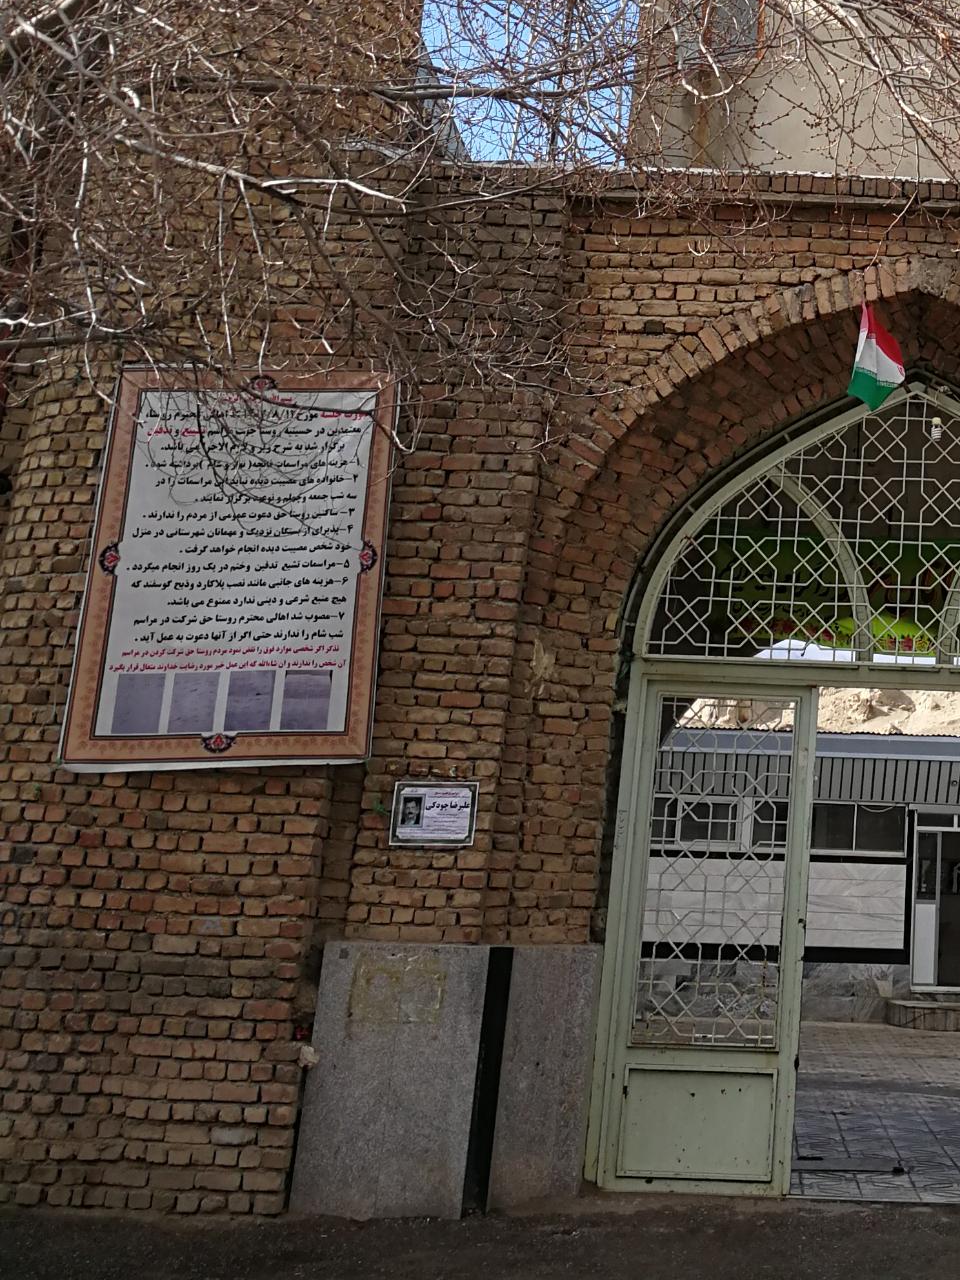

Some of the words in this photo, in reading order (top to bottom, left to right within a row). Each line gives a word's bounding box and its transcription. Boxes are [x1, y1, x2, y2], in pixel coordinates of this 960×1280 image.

[296, 410, 318, 421] مورخ
[284, 427, 313, 437] حسینیه
[314, 427, 325, 437] در
[272, 441, 293, 454] شرح
[294, 444, 303, 452] به
[304, 441, 318, 451] شد
[311, 460, 326, 470] های
[155, 478, 165, 488] در
[177, 476, 212, 488] مراسمات
[249, 478, 269, 487] دیده
[271, 477, 297, 487] مصیبت
[298, 476, 315, 487] های
[201, 492, 224, 504] نمایند
[308, 493, 328, 502] جمعه
[330, 491, 344, 501] شب
[346, 492, 358, 500] سه
[148, 510, 175, 521] ندارند
[177, 511, 185, 522] را
[185, 513, 208, 522] مردم
[209, 510, 218, 522] از
[219, 511, 247, 522] عمومی
[248, 511, 272, 521] دعوت
[273, 511, 287, 521] حق
[289, 509, 310, 521] روستا
[311, 509, 338, 520] ساکنین
[132, 527, 152, 539] منزل
[153, 528, 164, 539] در
[165, 527, 206, 539] شهرستانی
[206, 527, 238, 539] مهمانان
[246, 527, 273, 538] نزدیک
[303, 525, 311, 537] از
[184, 544, 209, 556] گرفت
[209, 544, 236, 556] خواهد
[237, 545, 260, 555] انجام
[260, 545, 280, 555] دیده
[281, 544, 308, 554] مصیبت
[308, 542, 334, 553] شخص
[335, 542, 352, 553] خود
[161, 562, 185, 573] انجام
[185, 564, 201, 573] روز
[202, 562, 217, 573] یک
[217, 563, 229, 573] در
[254, 561, 278, 572] تدفین
[130, 580, 142, 589] که
[143, 579, 173, 591] گوسفند
[195, 579, 225, 591] پلاکارد
[226, 579, 246, 590] نصب
[246, 579, 267, 588] مانند
[268, 578, 293, 589] جانبی
[293, 577, 311, 588] های
[190, 599, 205, 608] می
[205, 598, 231, 608] ممنوع
[233, 596, 256, 607] ندارد
[256, 596, 277, 607] دینی
[278, 598, 284, 607] و
[284, 594, 310, 607] شرعی
[331, 595, 347, 606] هیچ
[133, 614, 159, 626] مراسم
[159, 616, 171, 626] در
[171, 614, 198, 626] شرکت
[198, 615, 214, 625] حق
[214, 614, 238, 625] روستا
[239, 613, 265, 625] محترم
[265, 612, 290, 624] اهالی
[290, 611, 303, 621] شد
[139, 631, 156, 642] آید
[156, 632, 174, 643] عمل
[175, 633, 185, 643] به
[185, 631, 209, 643] دعوت
[211, 629, 228, 640] آنها
[228, 630, 238, 642] از
[238, 630, 252, 642] اگر
[252, 631, 272, 641] حتی
[273, 629, 300, 641] ندارند
[300, 629, 310, 640] را
[310, 628, 327, 640] شام
[328, 629, 344, 640] شب
[121, 648, 140, 658] مراسم
[140, 650, 149, 658] در
[149, 648, 166, 658] کردن
[166, 648, 184, 658] شرکت
[184, 649, 195, 657] حق
[196, 648, 212, 657] روستا
[212, 648, 228, 656] مردم
[256, 646, 263, 655] را
[263, 645, 275, 655] فوق
[275, 646, 293, 655] موارد
[292, 644, 314, 655] شخصی
[314, 644, 325, 655] اگر
[325, 644, 340, 654] تذکر
[126, 663, 140, 672] قرار
[139, 663, 156, 672] متعال
[198, 662, 213, 671] مورد
[238, 660, 249, 670] این
[249, 660, 257, 668] که
[291, 660, 311, 669] ندارند
[311, 660, 318, 669] را
[318, 660, 337, 669] شخص
[425, 801, 449, 811] جودکی
[449, 801, 471, 811] علیرضا
